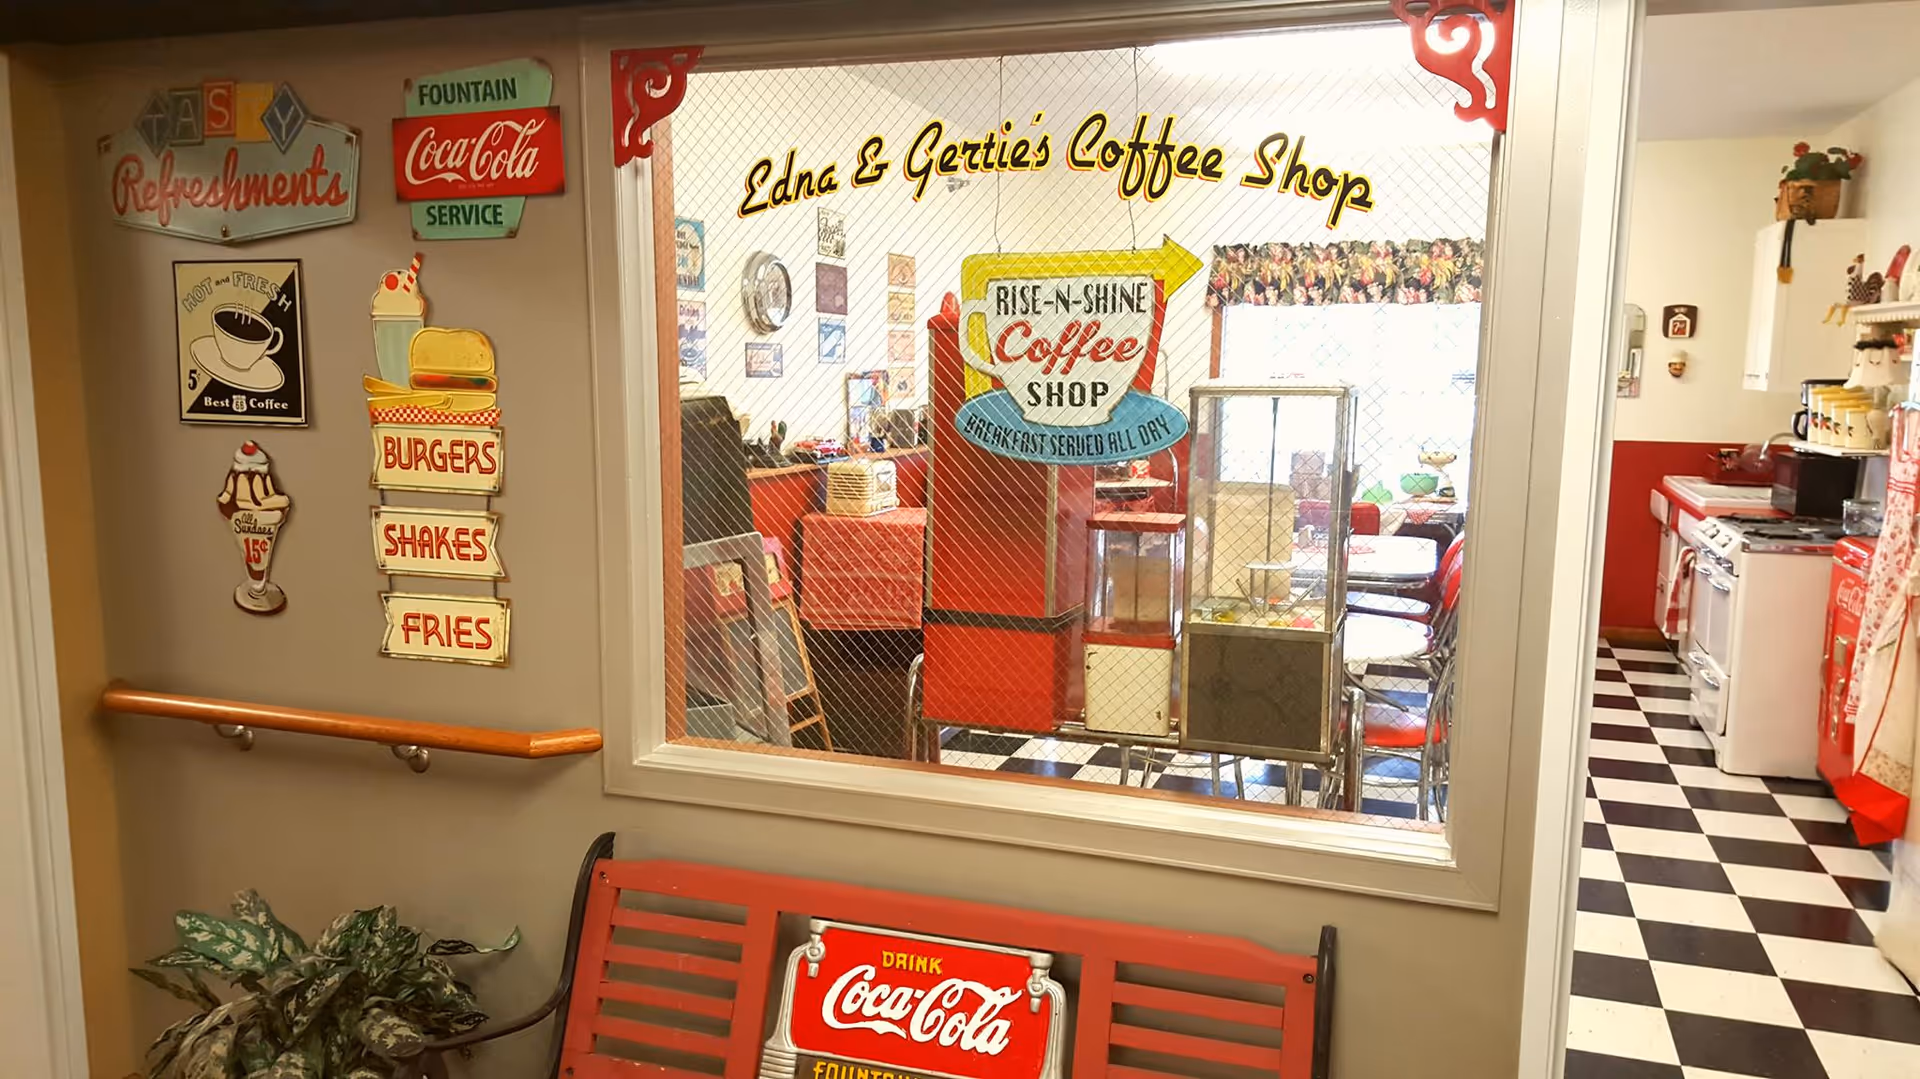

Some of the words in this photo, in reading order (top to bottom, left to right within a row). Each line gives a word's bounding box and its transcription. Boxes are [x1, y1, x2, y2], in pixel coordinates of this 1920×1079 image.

[417, 77, 518, 106] FOUNTAIN
[146, 84, 296, 143] TASY
[404, 118, 547, 186] Coca-Cola
[737, 147, 840, 219] Edna
[851, 135, 892, 189] &
[904, 110, 1052, 202] Gertie's
[1065, 110, 1225, 203] Coffee
[1239, 131, 1376, 230] Shop
[112, 144, 349, 227] Refreshments
[426, 204, 503, 226] SERVICE
[182, 276, 213, 313] HOT
[215, 276, 231, 287] and
[232, 271, 293, 313] FRESH
[996, 282, 1148, 316] RISE-N-SHINE
[996, 320, 1144, 376] Coffee
[203, 396, 230, 408] Best
[249, 398, 289, 410] Coffee
[1027, 381, 1109, 408] SHOP
[963, 413, 1048, 456] BREAKFAST
[1049, 431, 1104, 457] SERVED
[1109, 427, 1137, 455] ALL
[1140, 414, 1171, 446] DAY
[383, 436, 497, 475] BURGERS
[383, 524, 488, 562] SHAKES
[401, 612, 493, 650] FRIES
[882, 950, 943, 975] DRINK
[821, 964, 1022, 1056] Coca-Cola
[813, 1061, 922, 1079] FOUN
